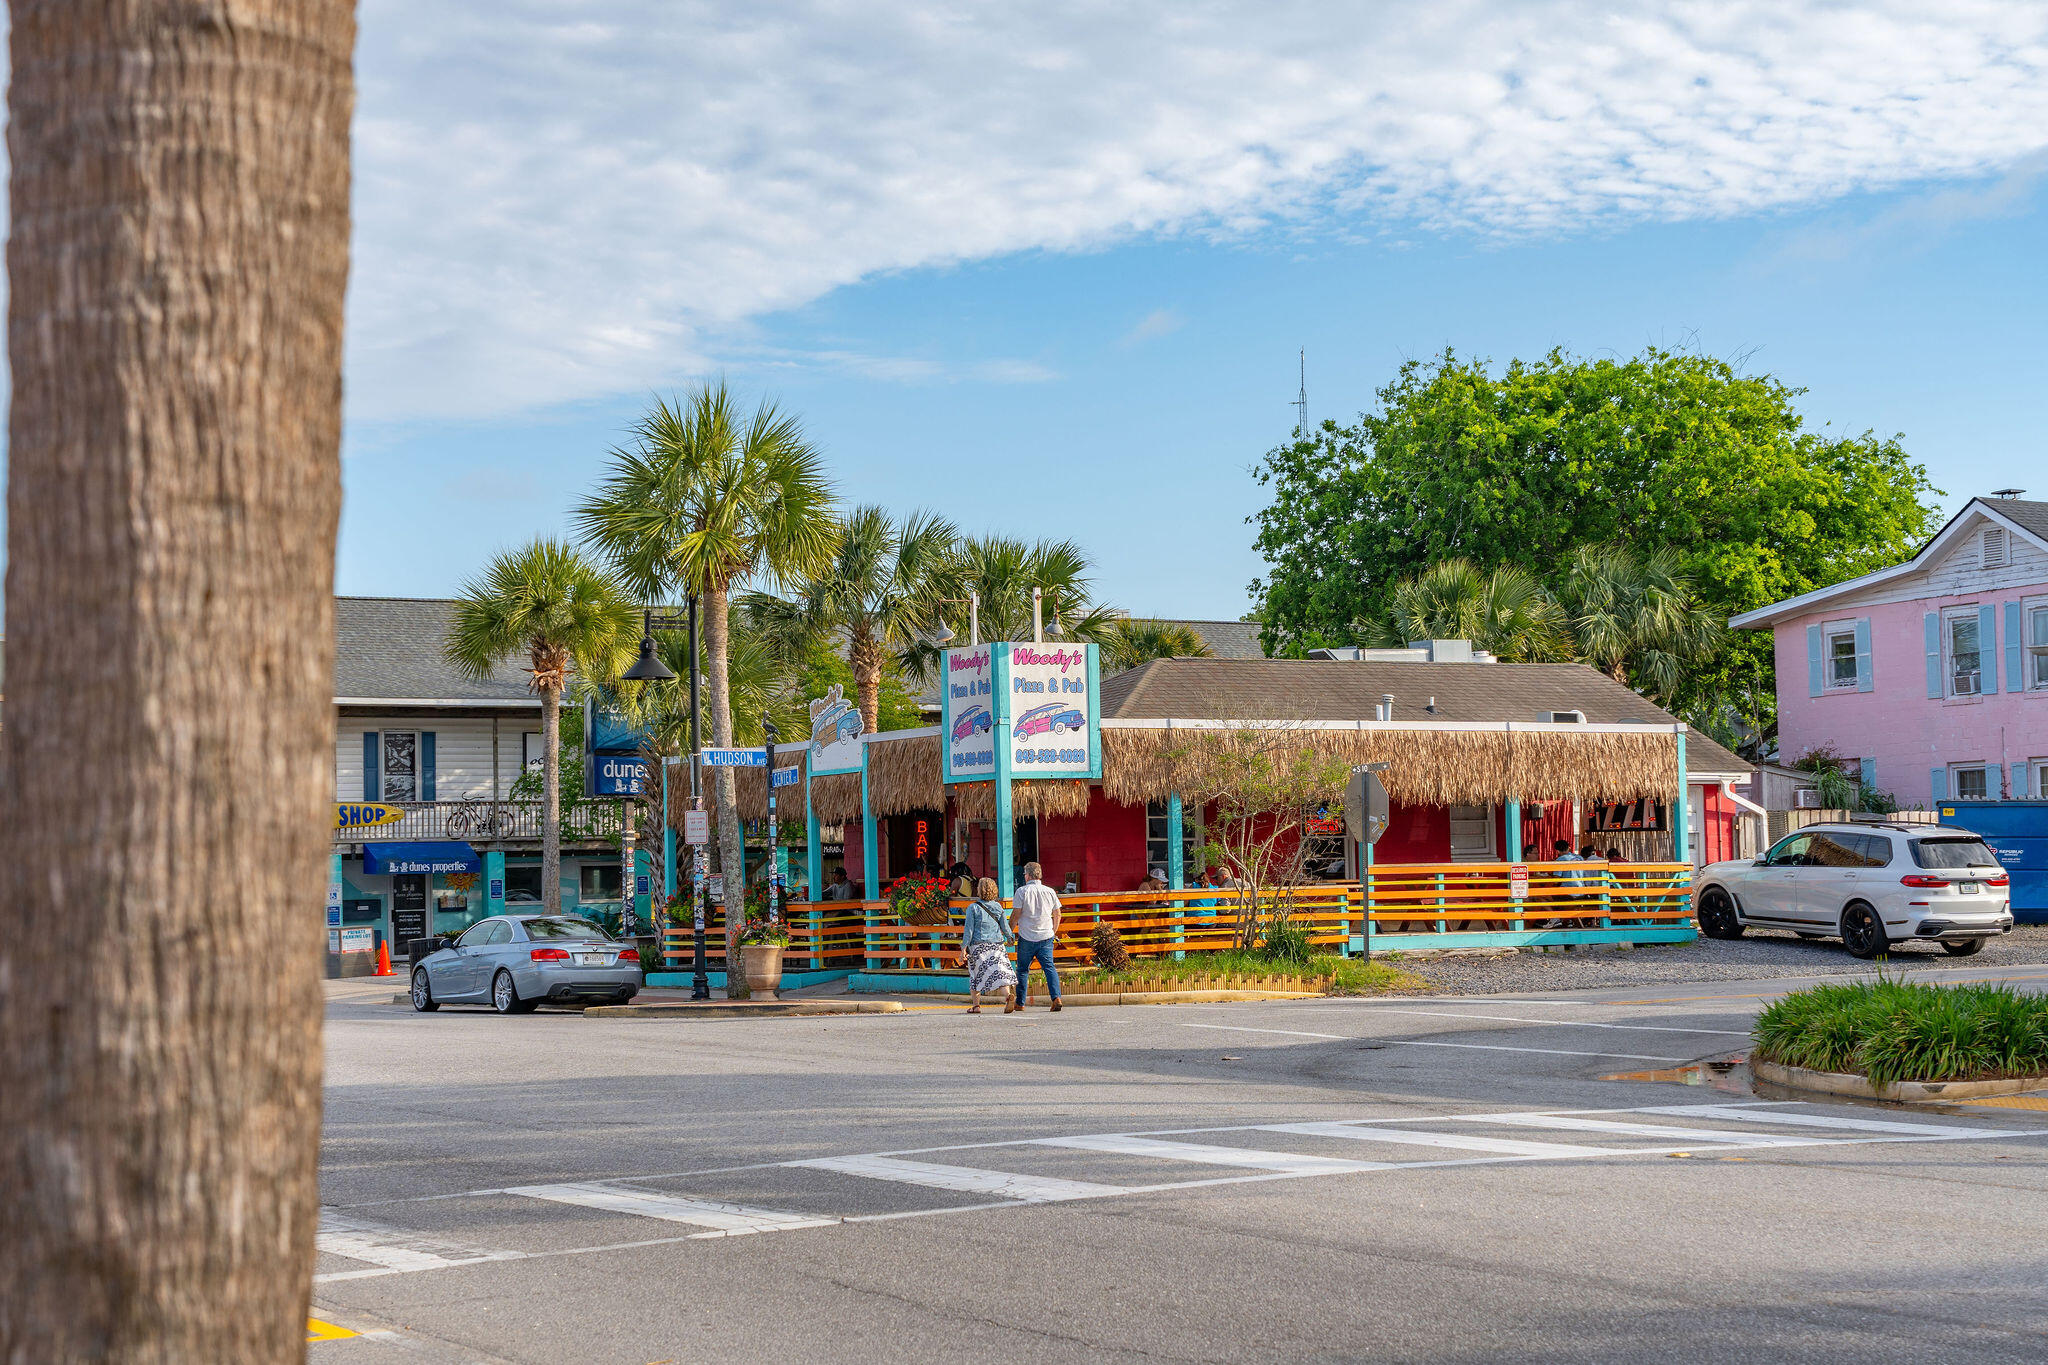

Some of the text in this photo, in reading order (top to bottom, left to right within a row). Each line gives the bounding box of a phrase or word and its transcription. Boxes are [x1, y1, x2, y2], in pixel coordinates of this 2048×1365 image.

[950, 651, 990, 675] Woody's
[1013, 648, 1083, 673] Woody's
[951, 678, 991, 699] Pizza & Pub
[1013, 677, 1084, 693] Pizza & Pub
[714, 752, 753, 765] HUDSON
[1016, 748, 1085, 763] 843-588-0088
[774, 771, 792, 786] CENTER
[339, 805, 386, 826] SHOP
[409, 861, 467, 873] dunes properties
